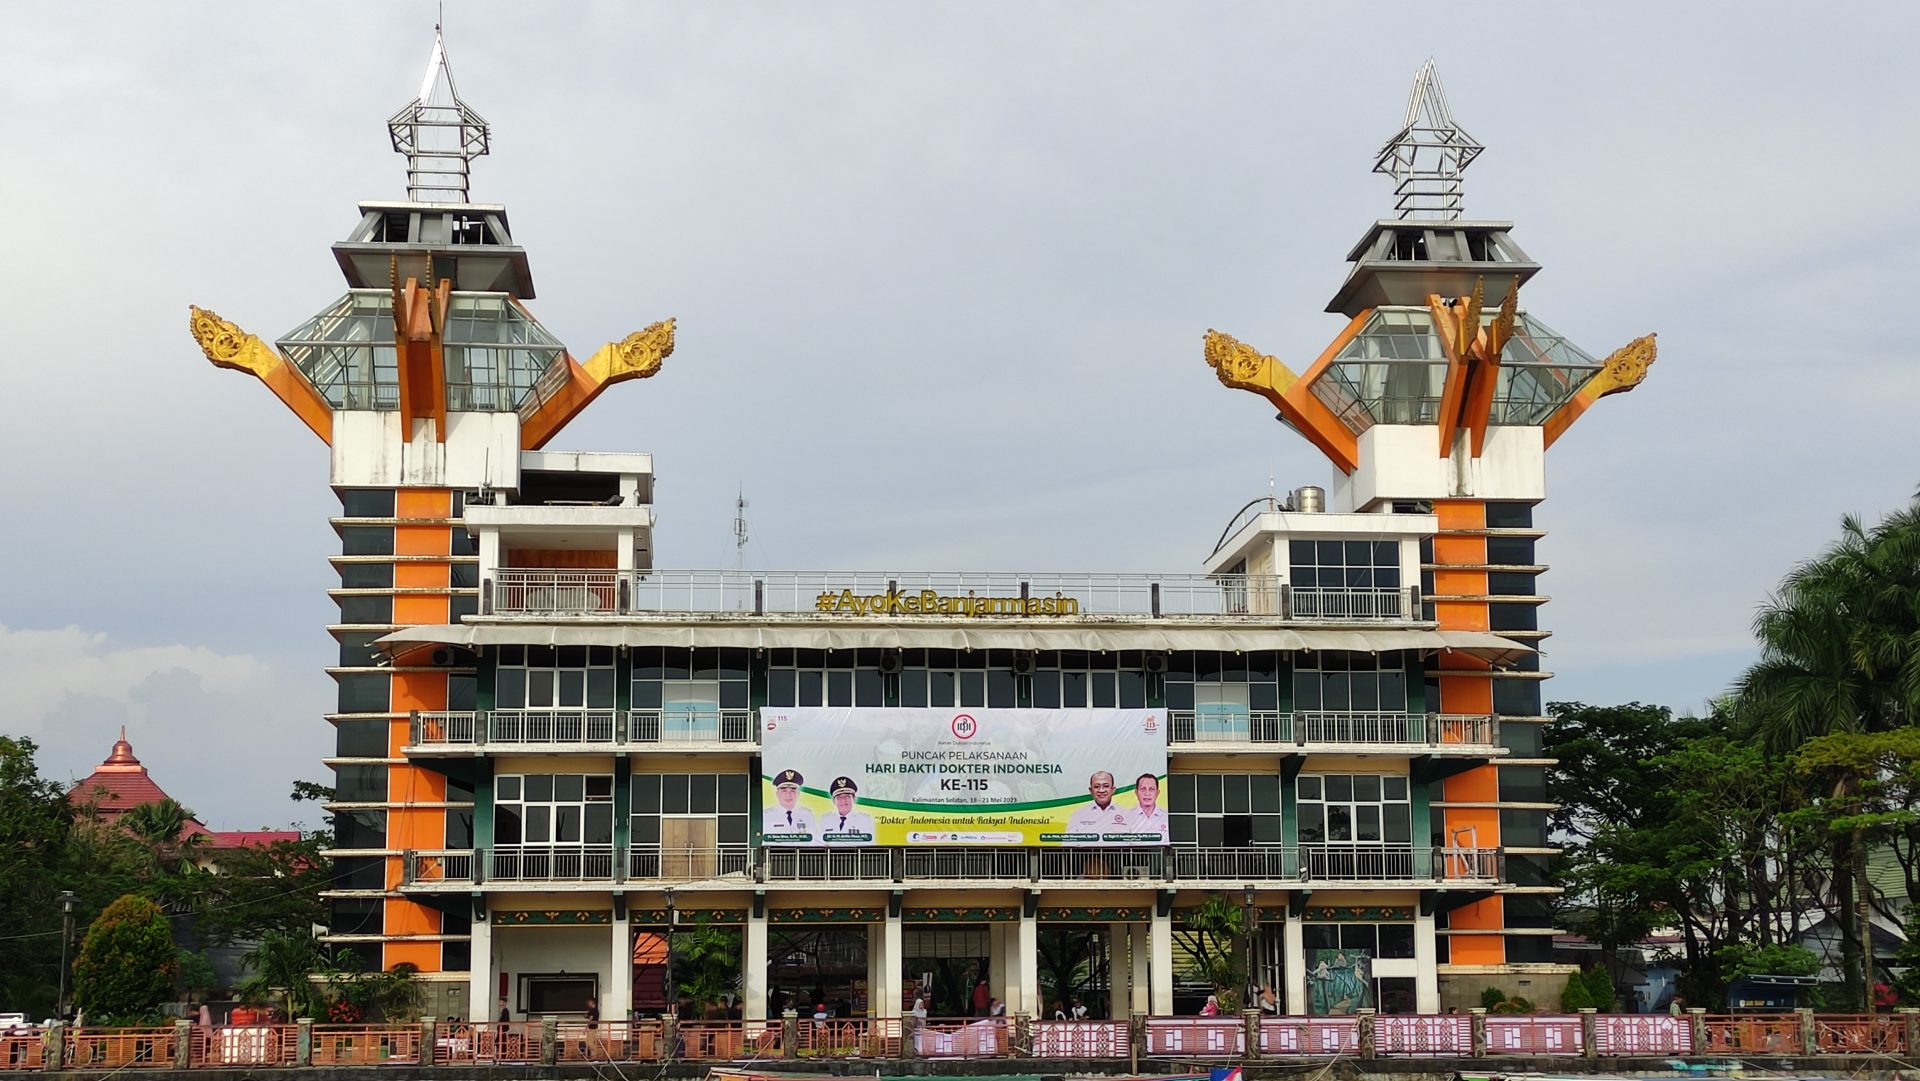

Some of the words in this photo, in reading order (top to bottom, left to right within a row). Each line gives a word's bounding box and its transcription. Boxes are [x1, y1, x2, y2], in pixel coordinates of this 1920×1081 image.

[816, 589, 1079, 616] #AyoKeBanjarmasin
[901, 751, 946, 760] PUNCAK
[948, 751, 1028, 760] PELAKSANAAN
[865, 763, 896, 774] HARI
[899, 763, 936, 774] BAKTI
[939, 763, 990, 774] DOKTER
[993, 763, 1063, 774] INDONESIA
[940, 779, 988, 791] KE-115
[908, 815, 950, 825] Indonesia
[952, 816, 975, 825] untuk
[977, 815, 1006, 826] Rakyat
